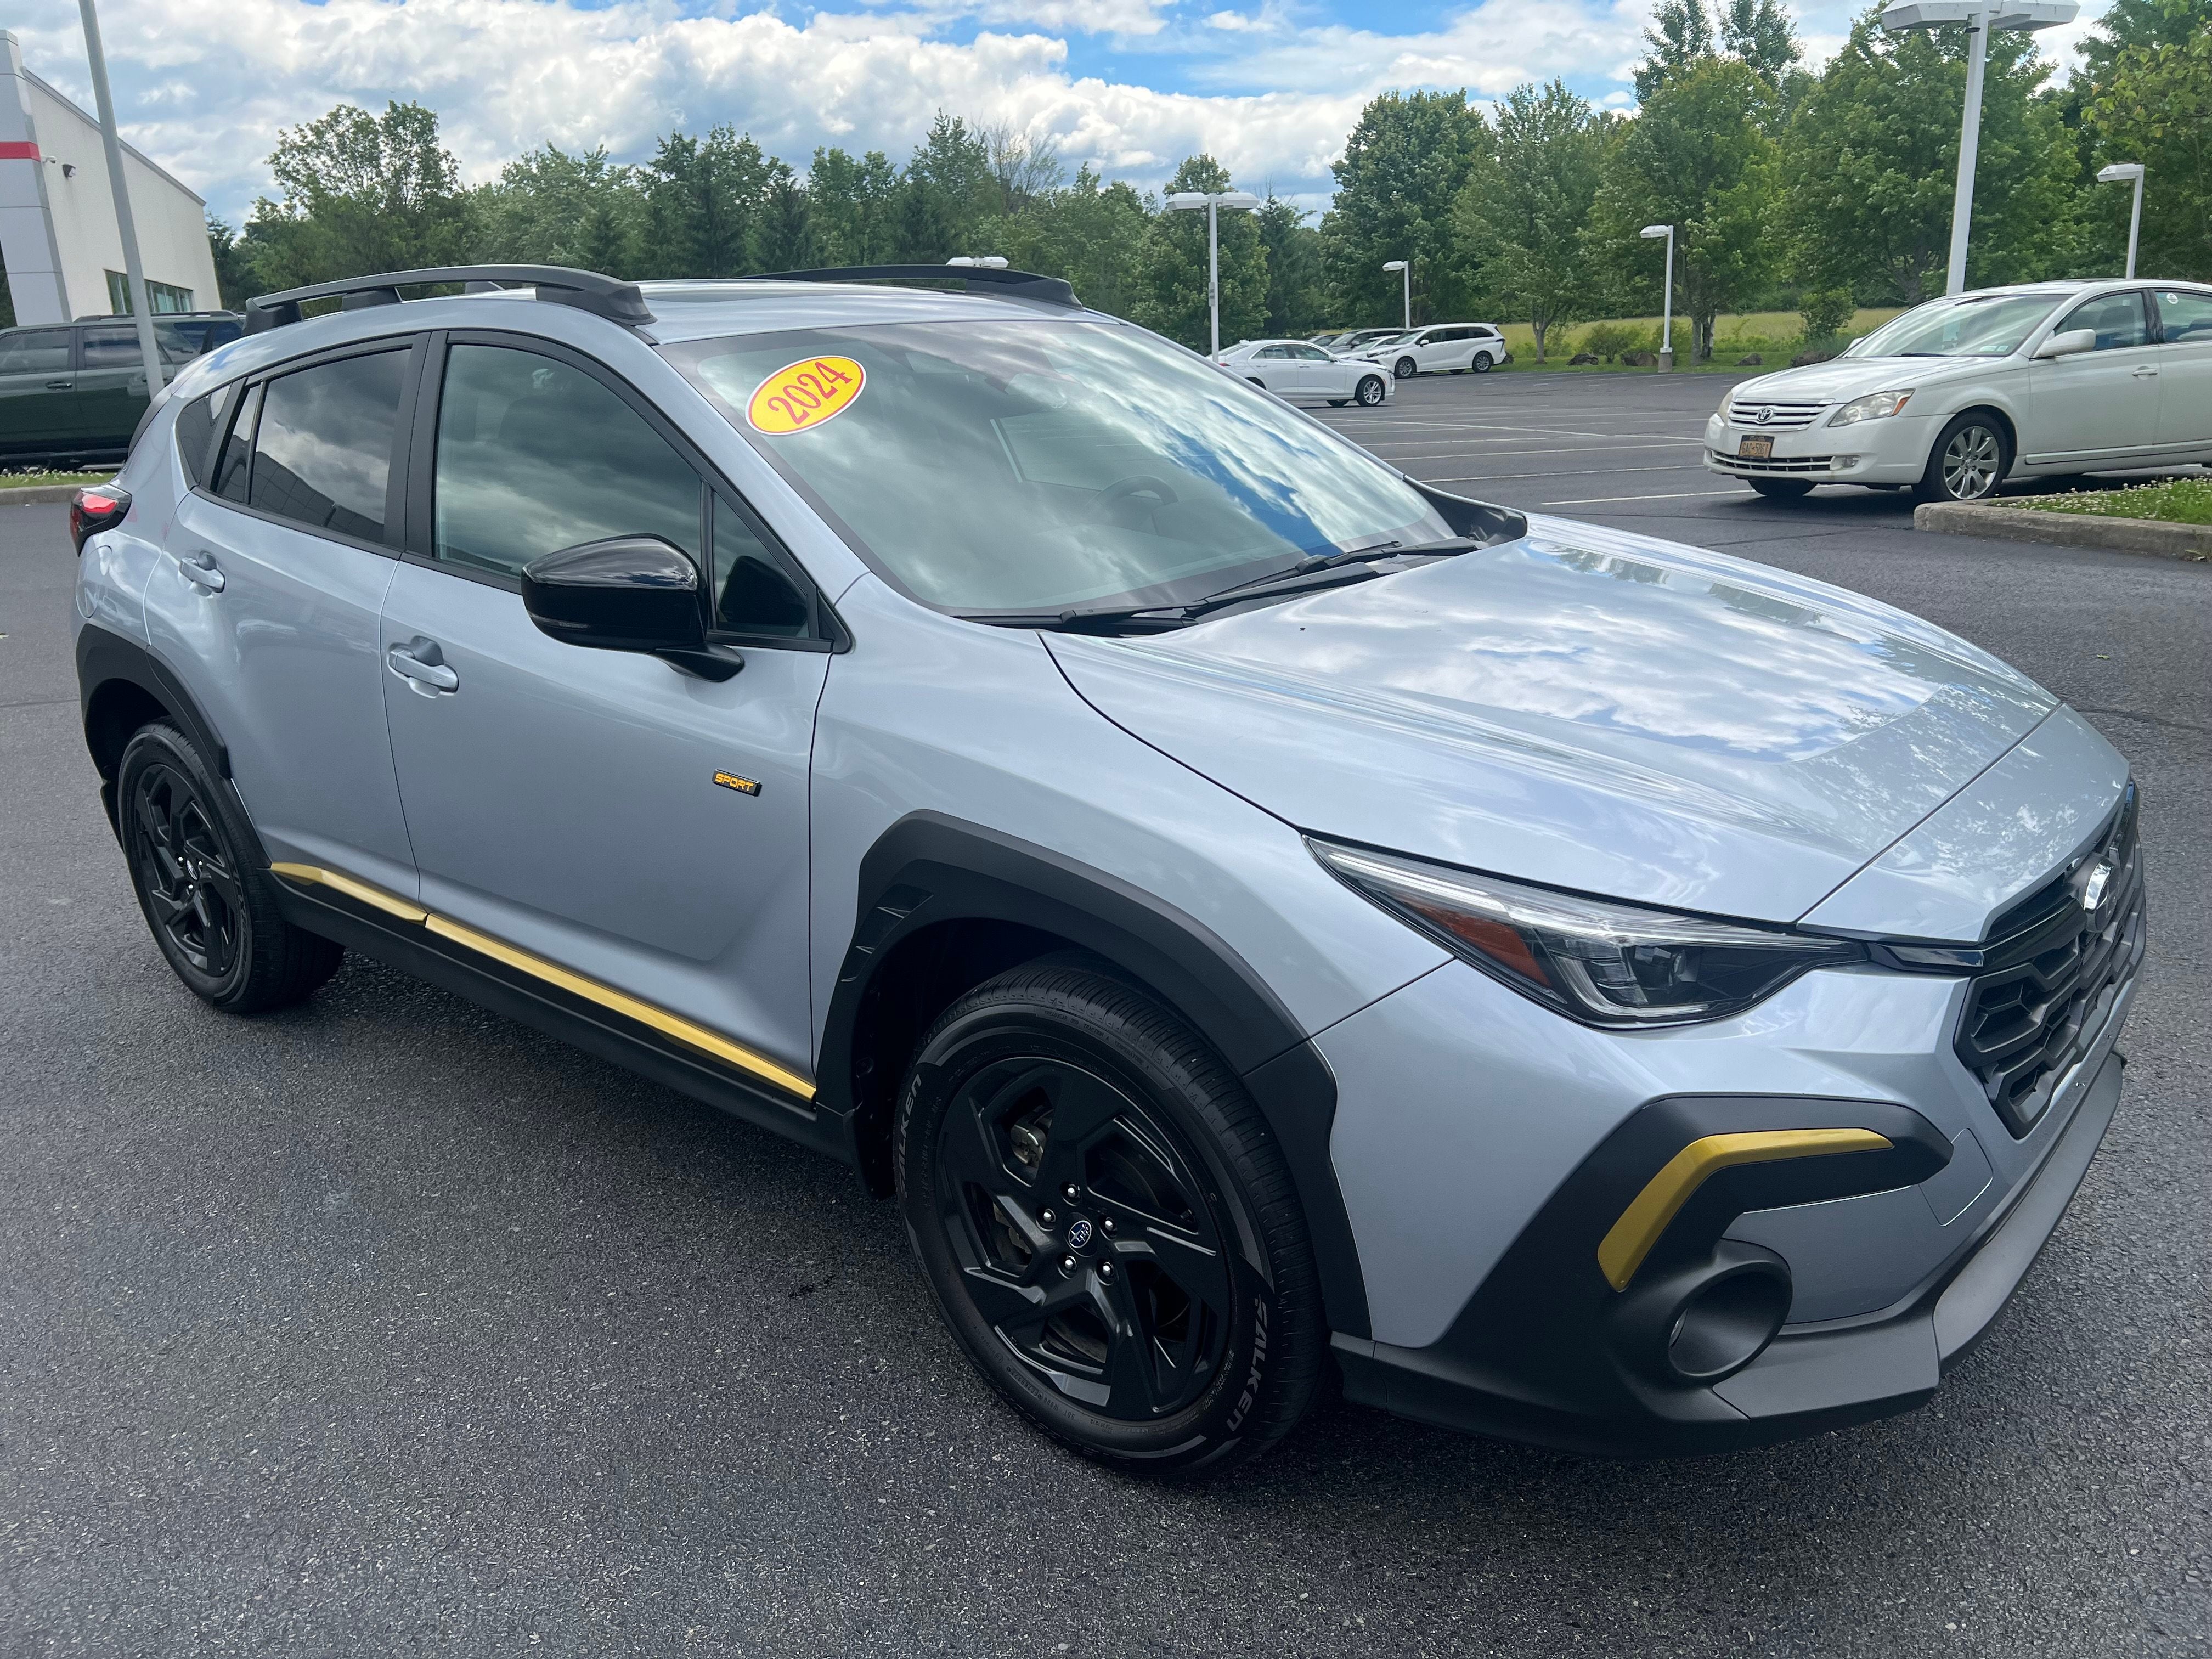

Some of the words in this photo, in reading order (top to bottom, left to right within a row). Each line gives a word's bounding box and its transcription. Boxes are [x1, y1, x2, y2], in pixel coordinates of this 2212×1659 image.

[768, 362, 853, 425] 2024
[714, 772, 754, 791] SPORT
[1226, 1294, 1267, 1431] FALKEN
